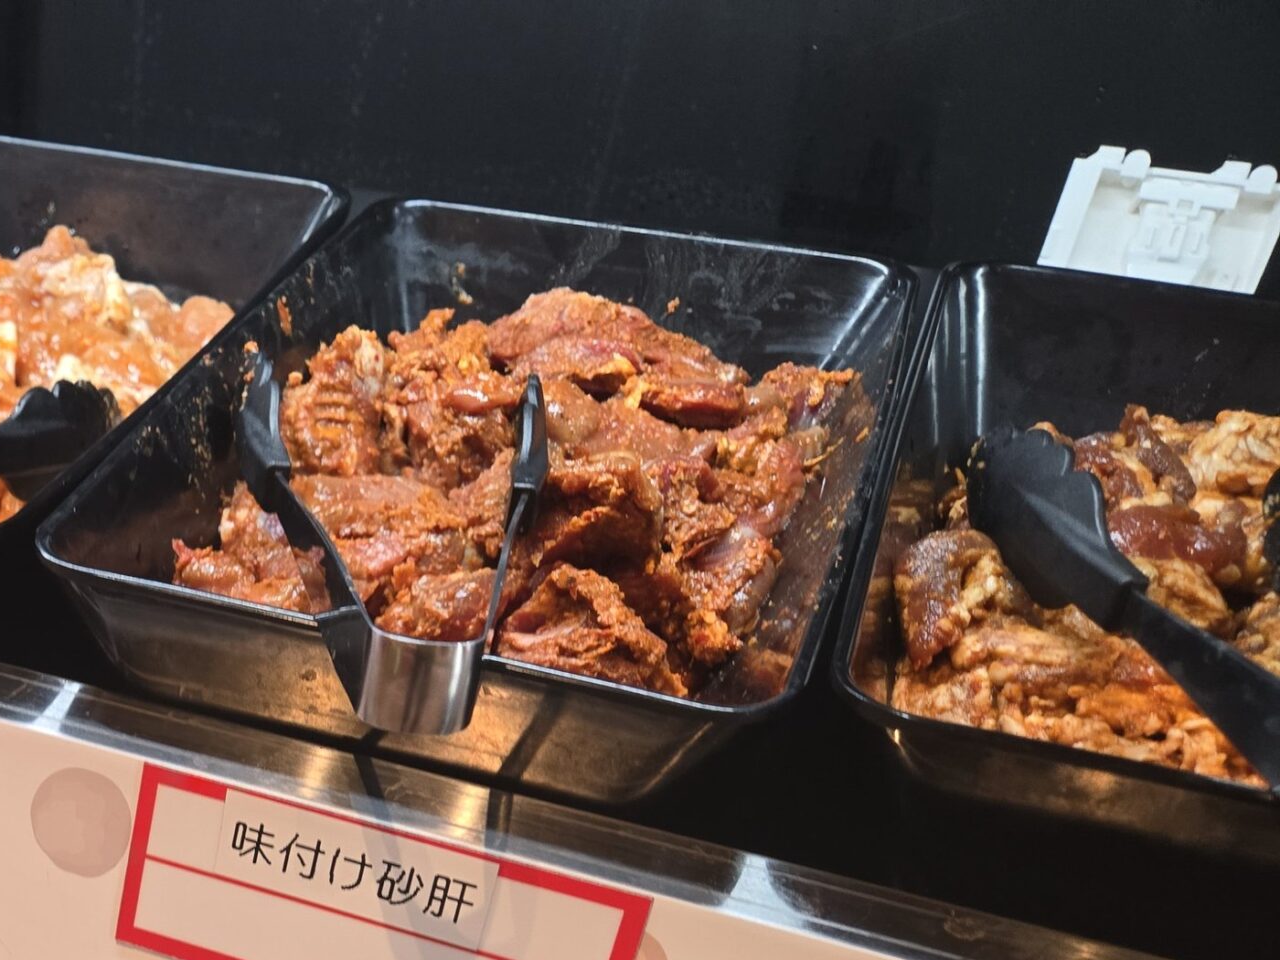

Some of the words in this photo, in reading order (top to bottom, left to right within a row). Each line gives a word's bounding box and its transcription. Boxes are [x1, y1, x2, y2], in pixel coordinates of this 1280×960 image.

[231, 821, 479, 926] 味付け砂肝
